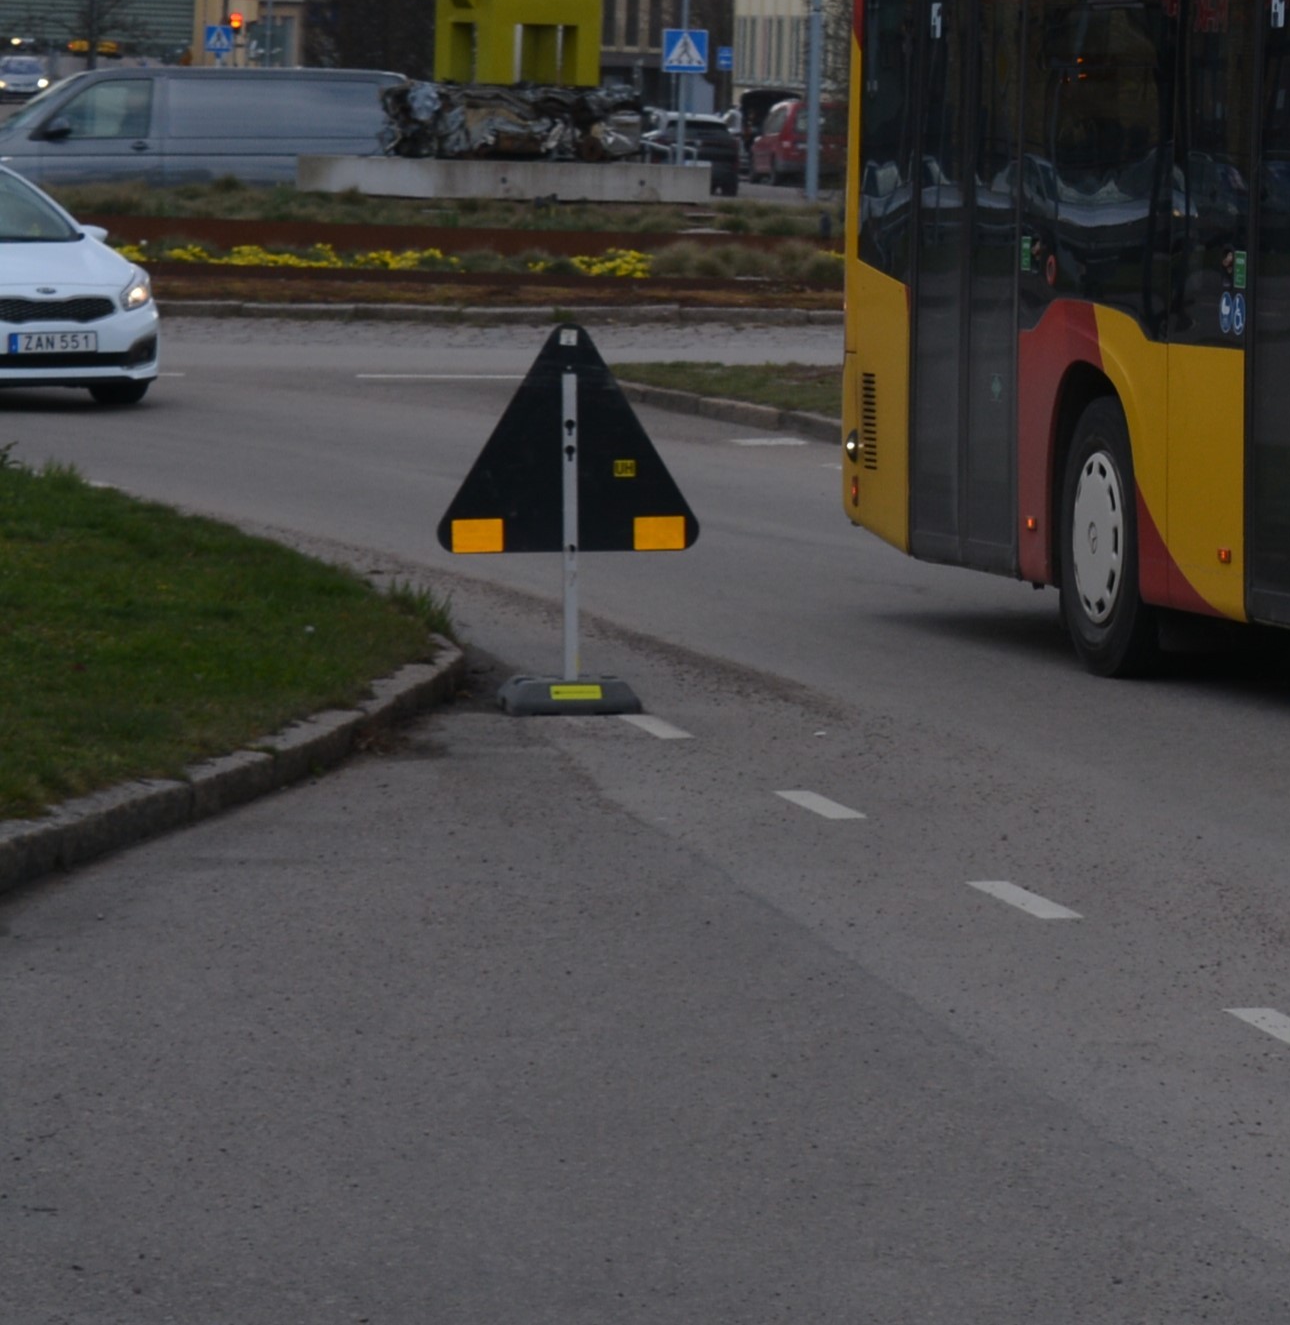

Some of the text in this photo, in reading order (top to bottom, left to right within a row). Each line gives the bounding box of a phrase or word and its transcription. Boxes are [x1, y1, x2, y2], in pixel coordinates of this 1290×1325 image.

[24, 334, 90, 351] ZAN 551
[615, 461, 635, 475] UH
